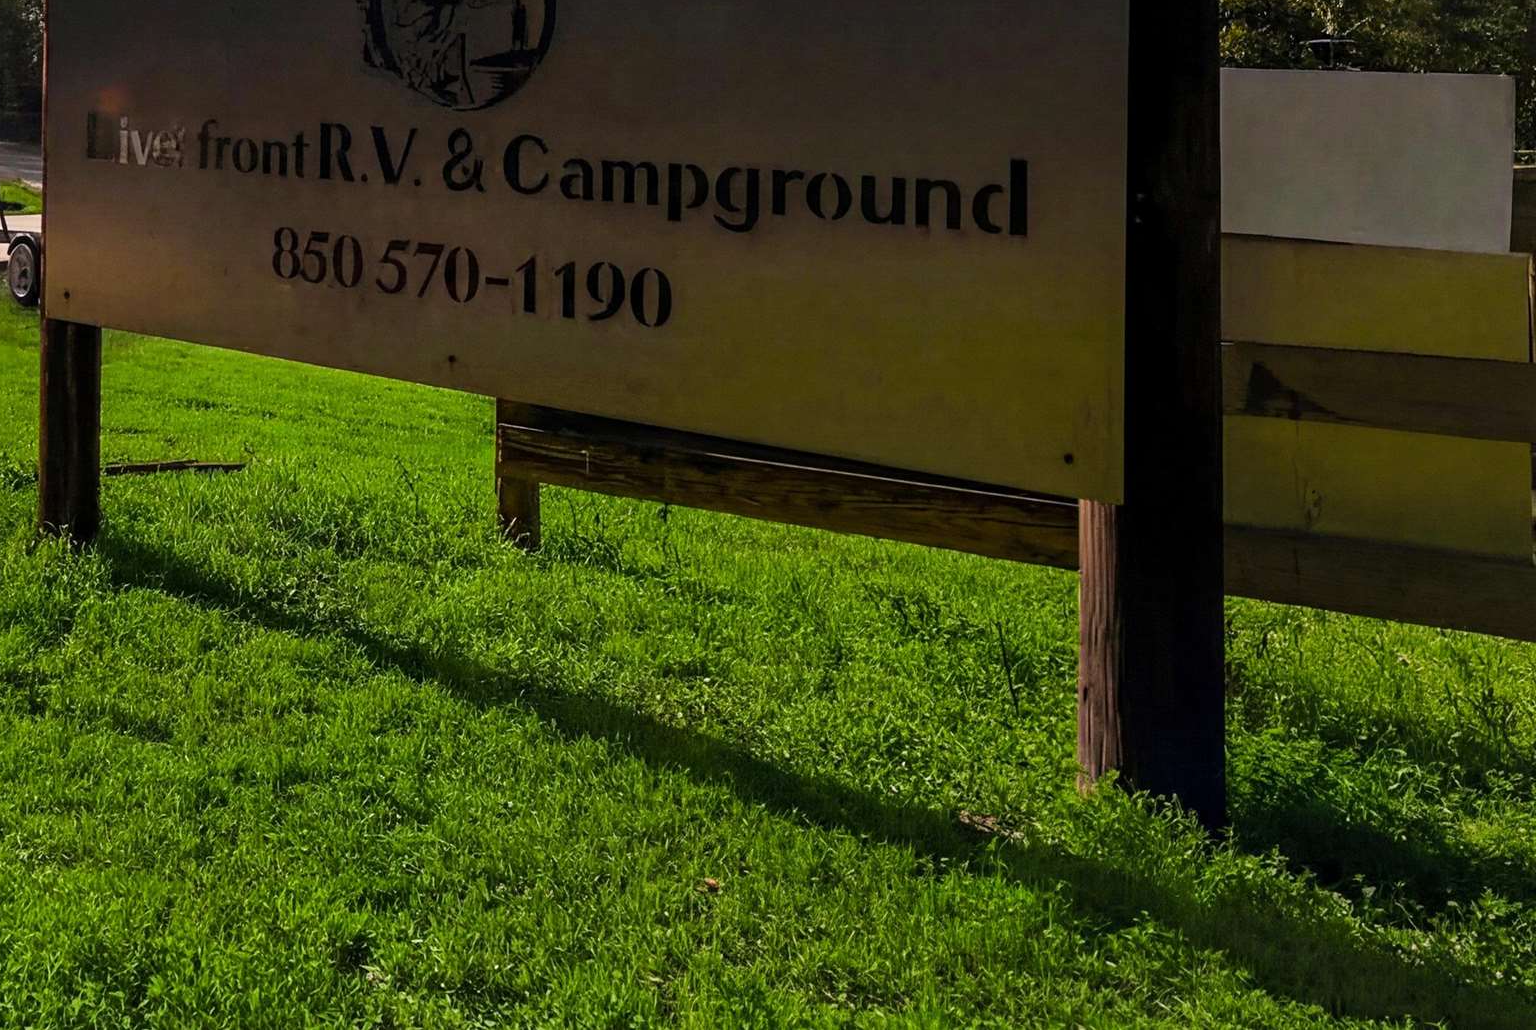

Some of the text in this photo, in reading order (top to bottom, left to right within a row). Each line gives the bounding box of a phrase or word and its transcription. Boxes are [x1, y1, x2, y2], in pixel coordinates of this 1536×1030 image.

[197, 119, 310, 179] front
[319, 122, 422, 187] R.V.
[442, 127, 485, 193] &
[503, 134, 1028, 236] Campground
[271, 226, 672, 328] 850 570-1190
